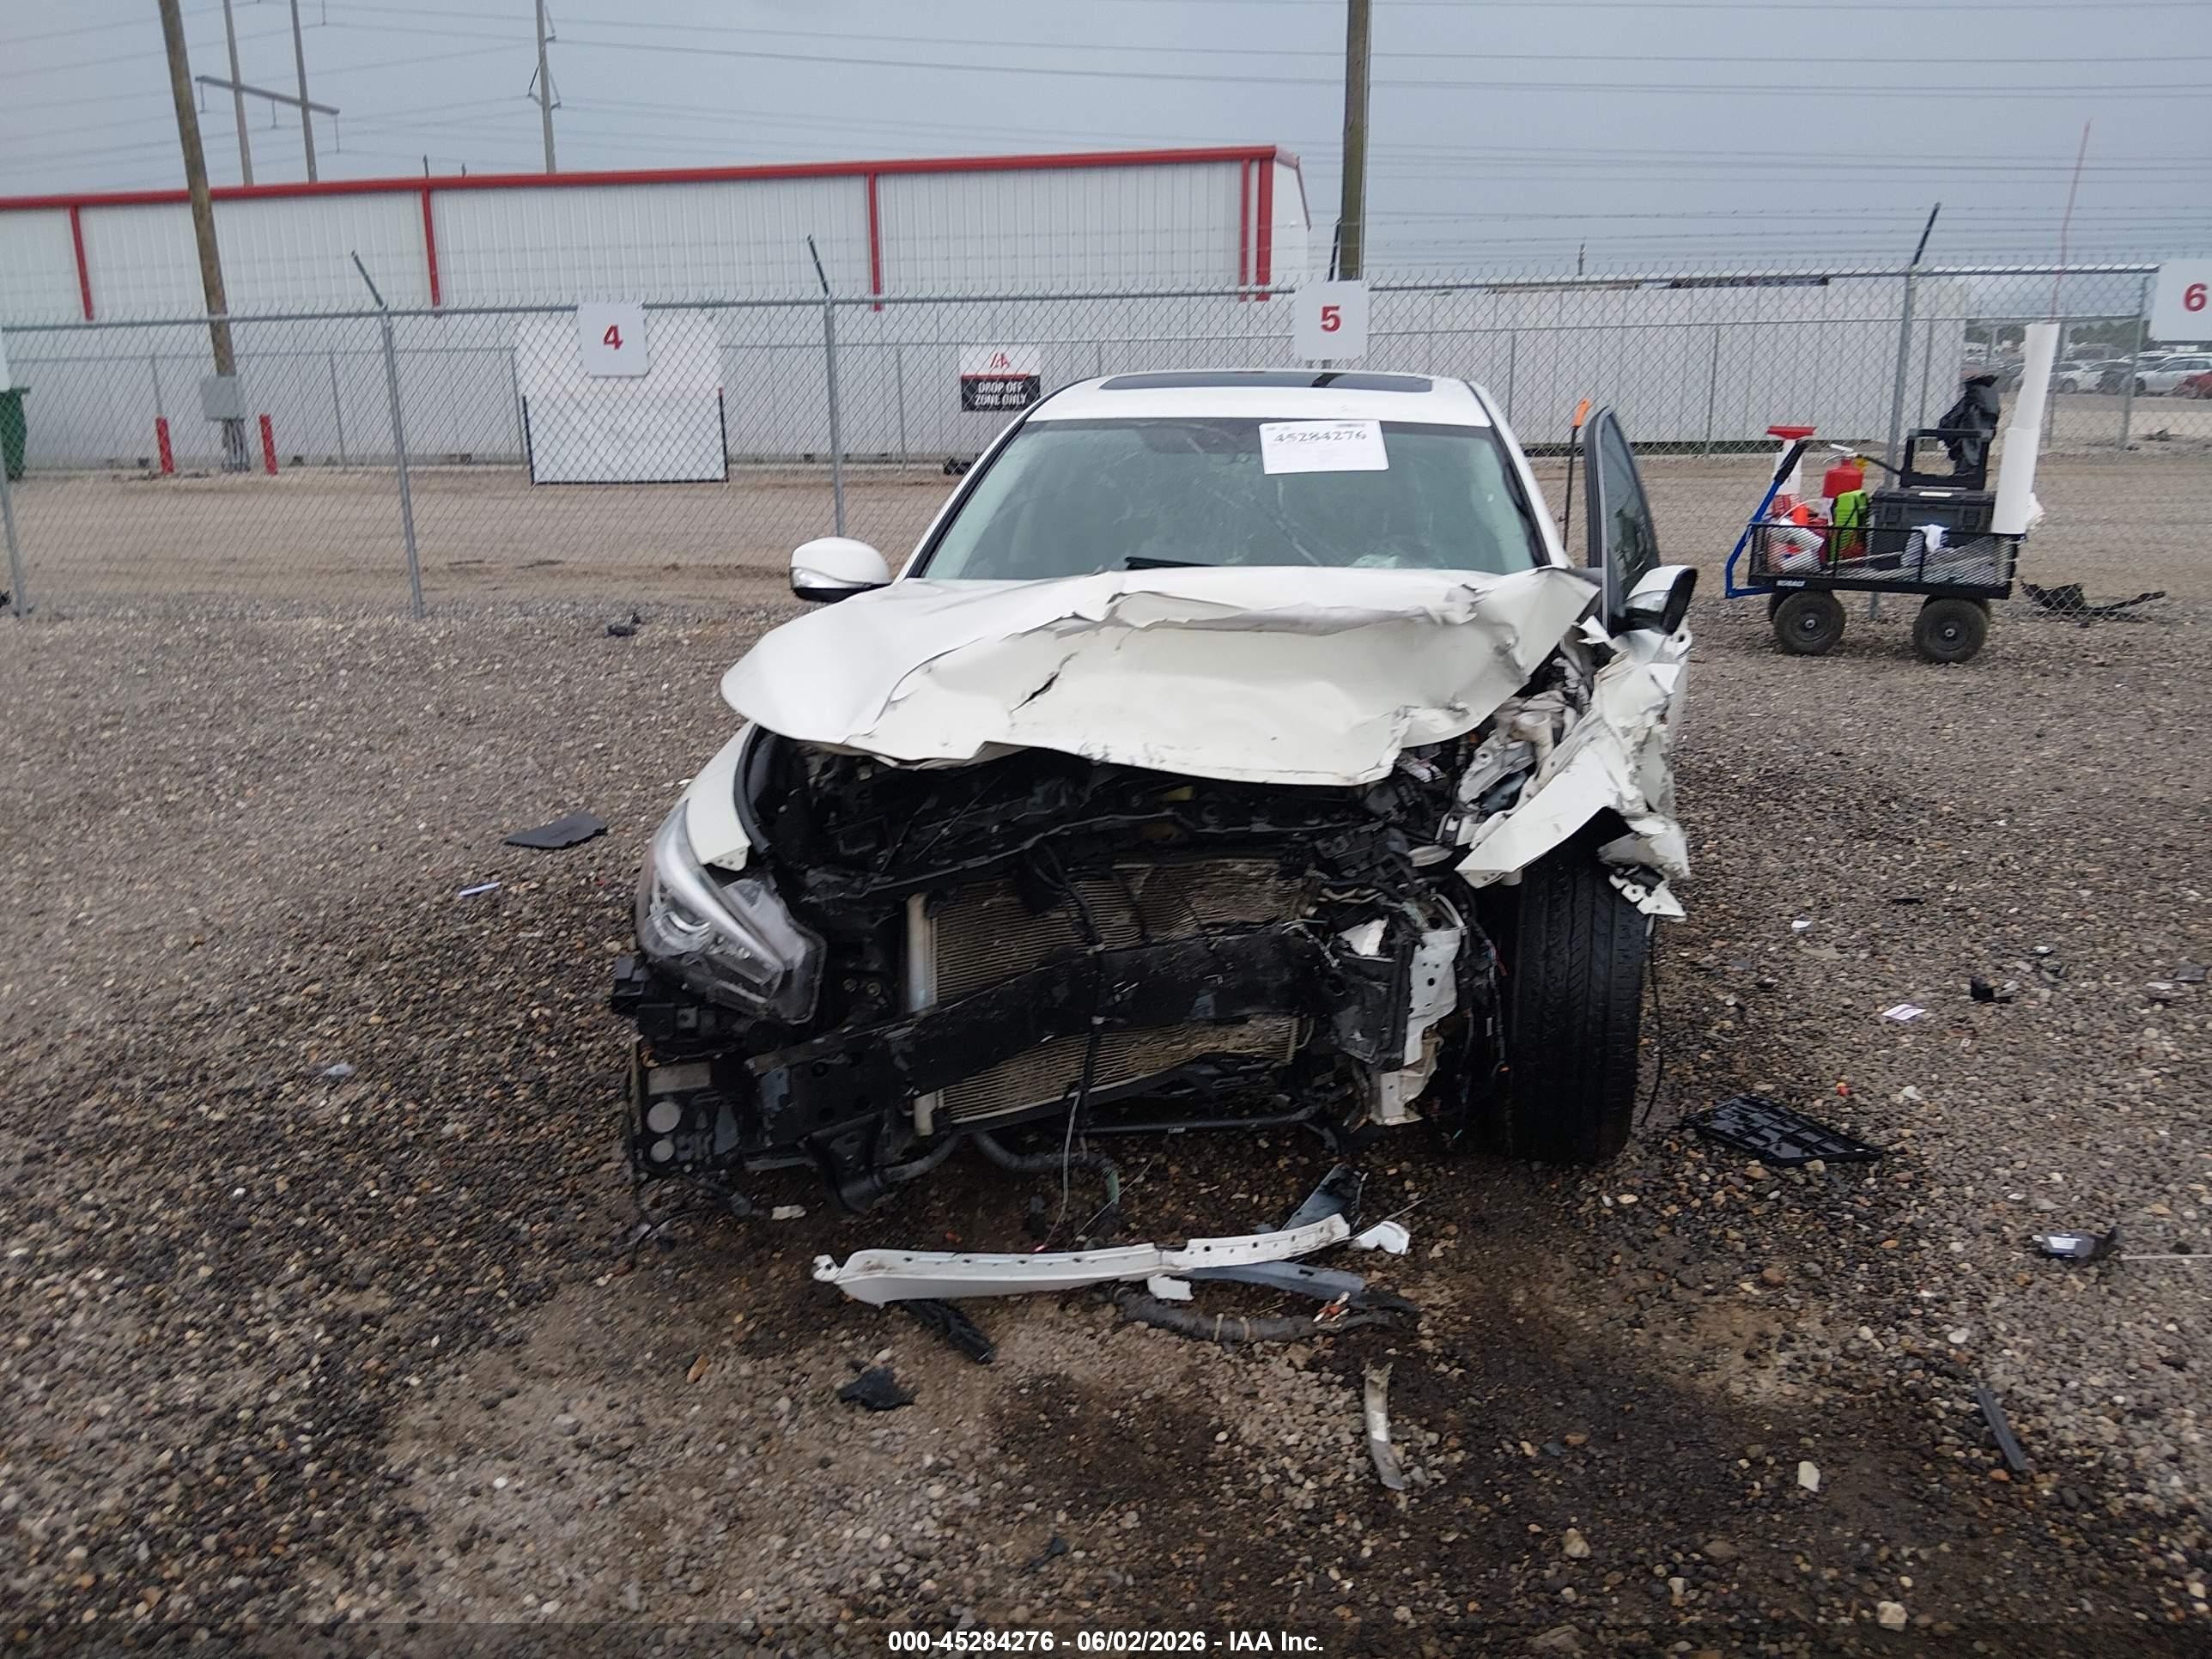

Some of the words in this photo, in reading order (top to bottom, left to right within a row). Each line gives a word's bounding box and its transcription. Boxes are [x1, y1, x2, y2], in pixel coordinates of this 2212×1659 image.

[2184, 283, 2208, 313] 6
[1321, 305, 1342, 332] 5
[603, 324, 623, 350] 4
[974, 393, 1001, 406] ZONE
[1001, 393, 1027, 406] ONLY
[977, 380, 1005, 394] DROP
[1006, 380, 1024, 394] OFF
